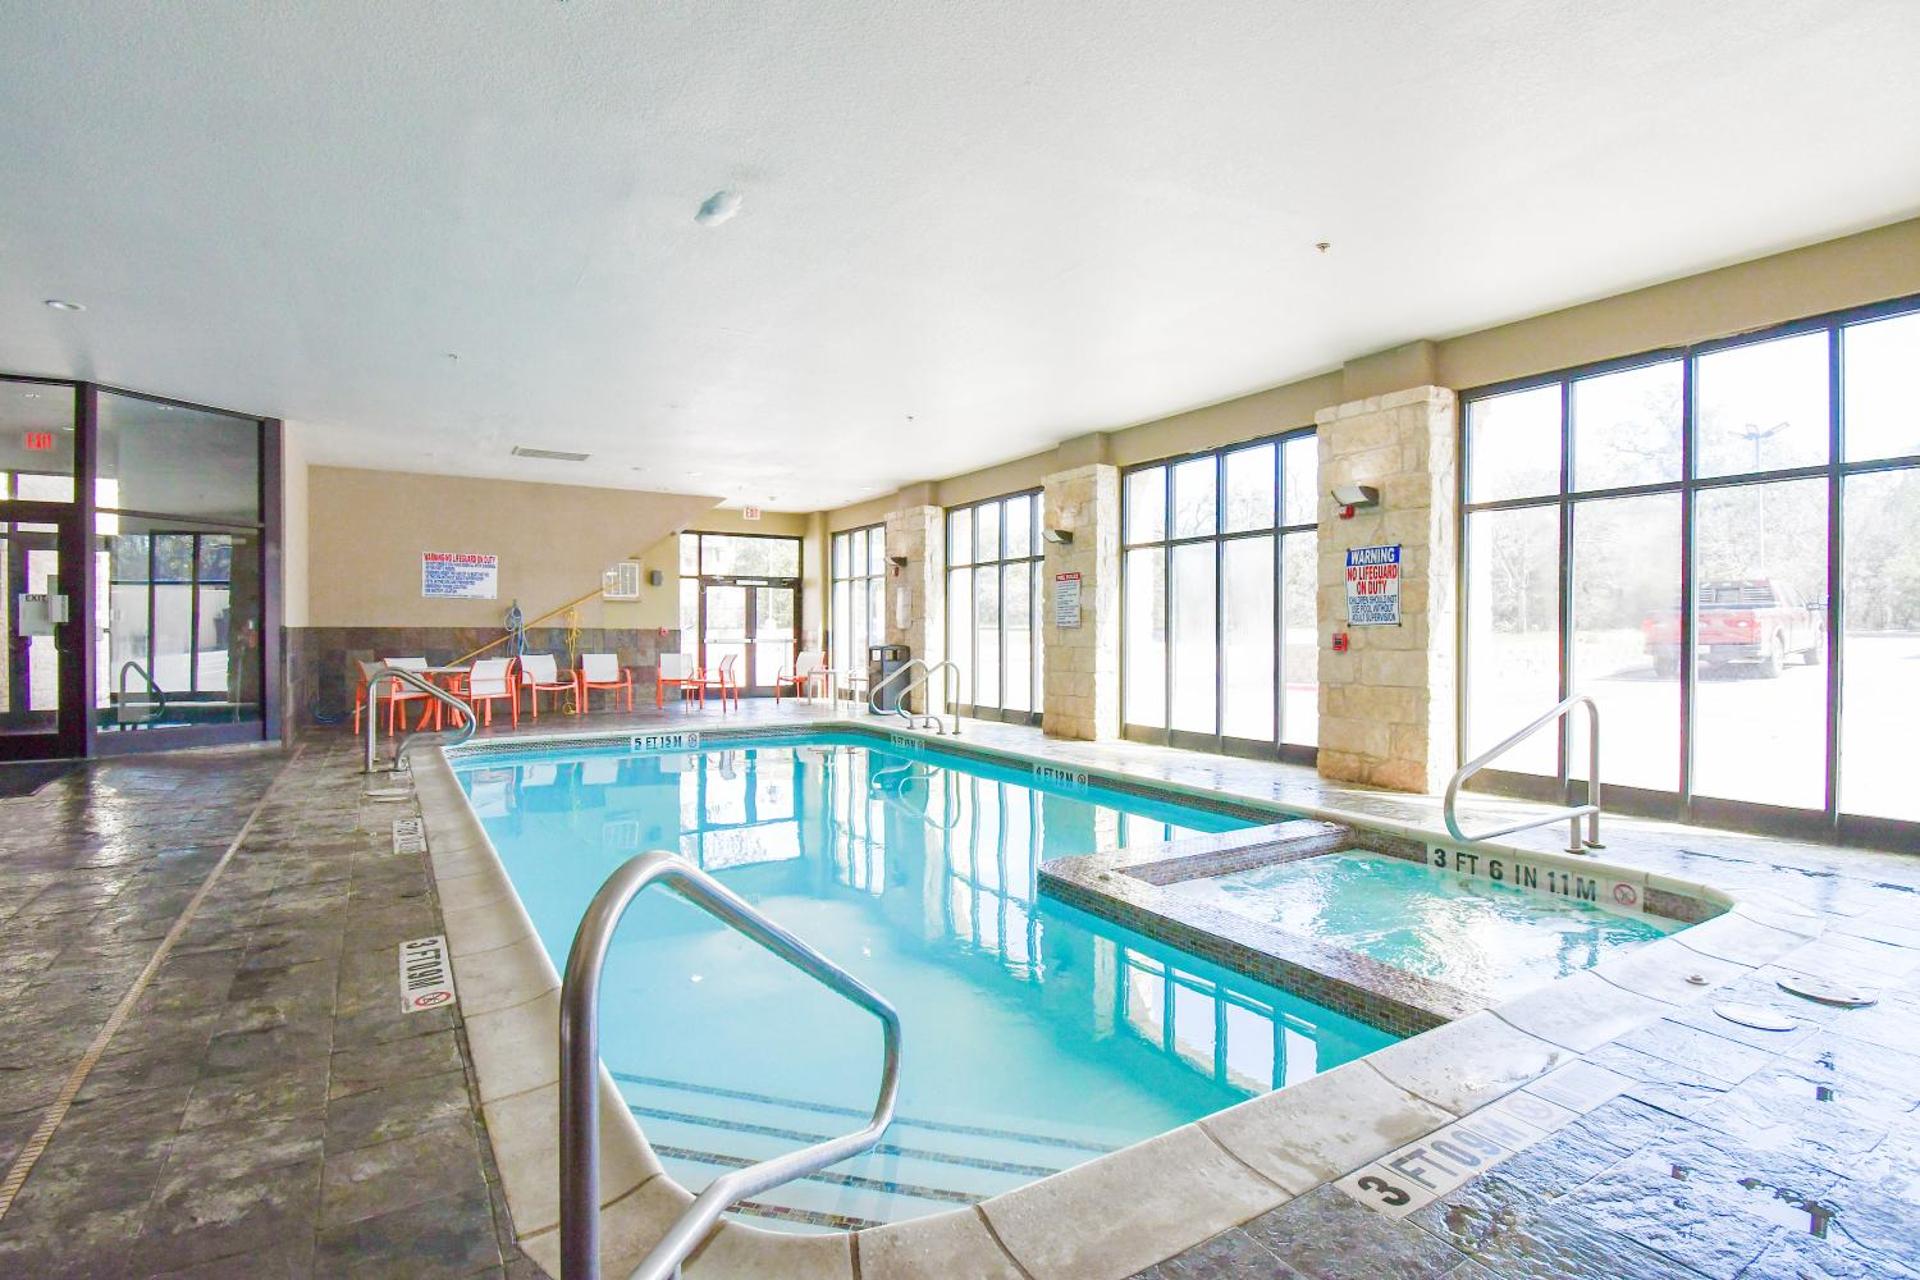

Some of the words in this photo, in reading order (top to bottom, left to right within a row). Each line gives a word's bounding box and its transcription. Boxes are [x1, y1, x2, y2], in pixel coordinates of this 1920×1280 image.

[26, 432, 51, 449] EXIT
[424, 553, 444, 561] WARNING
[453, 554, 476, 563] LIFEGUARD
[1351, 547, 1395, 566] WARNING
[1347, 567, 1357, 581] NO
[1359, 565, 1397, 580] LIFEGUARD
[1357, 581, 1366, 595] ON
[1368, 580, 1387, 594] DUTY
[1349, 596, 1369, 605] CHILDREN
[1369, 595, 1387, 604] SHOULD
[1387, 594, 1397, 603] NOT
[1351, 605, 1360, 613] USE
[1360, 604, 1373, 613] POOL
[1373, 603, 1393, 612] WITHOUT
[1352, 613, 1365, 622] ADULT
[1366, 612, 1396, 622] SUPERVISION
[635, 738, 641, 750] 5
[646, 737, 657, 749] FT
[1044, 767, 1054, 777] FT
[1434, 848, 1446, 868] 3
[1456, 852, 1478, 875] FT
[1489, 860, 1503, 880] 6
[1515, 864, 1537, 888] IN
[406, 940, 438, 949] 3
[1358, 1175, 1411, 1206] 3
